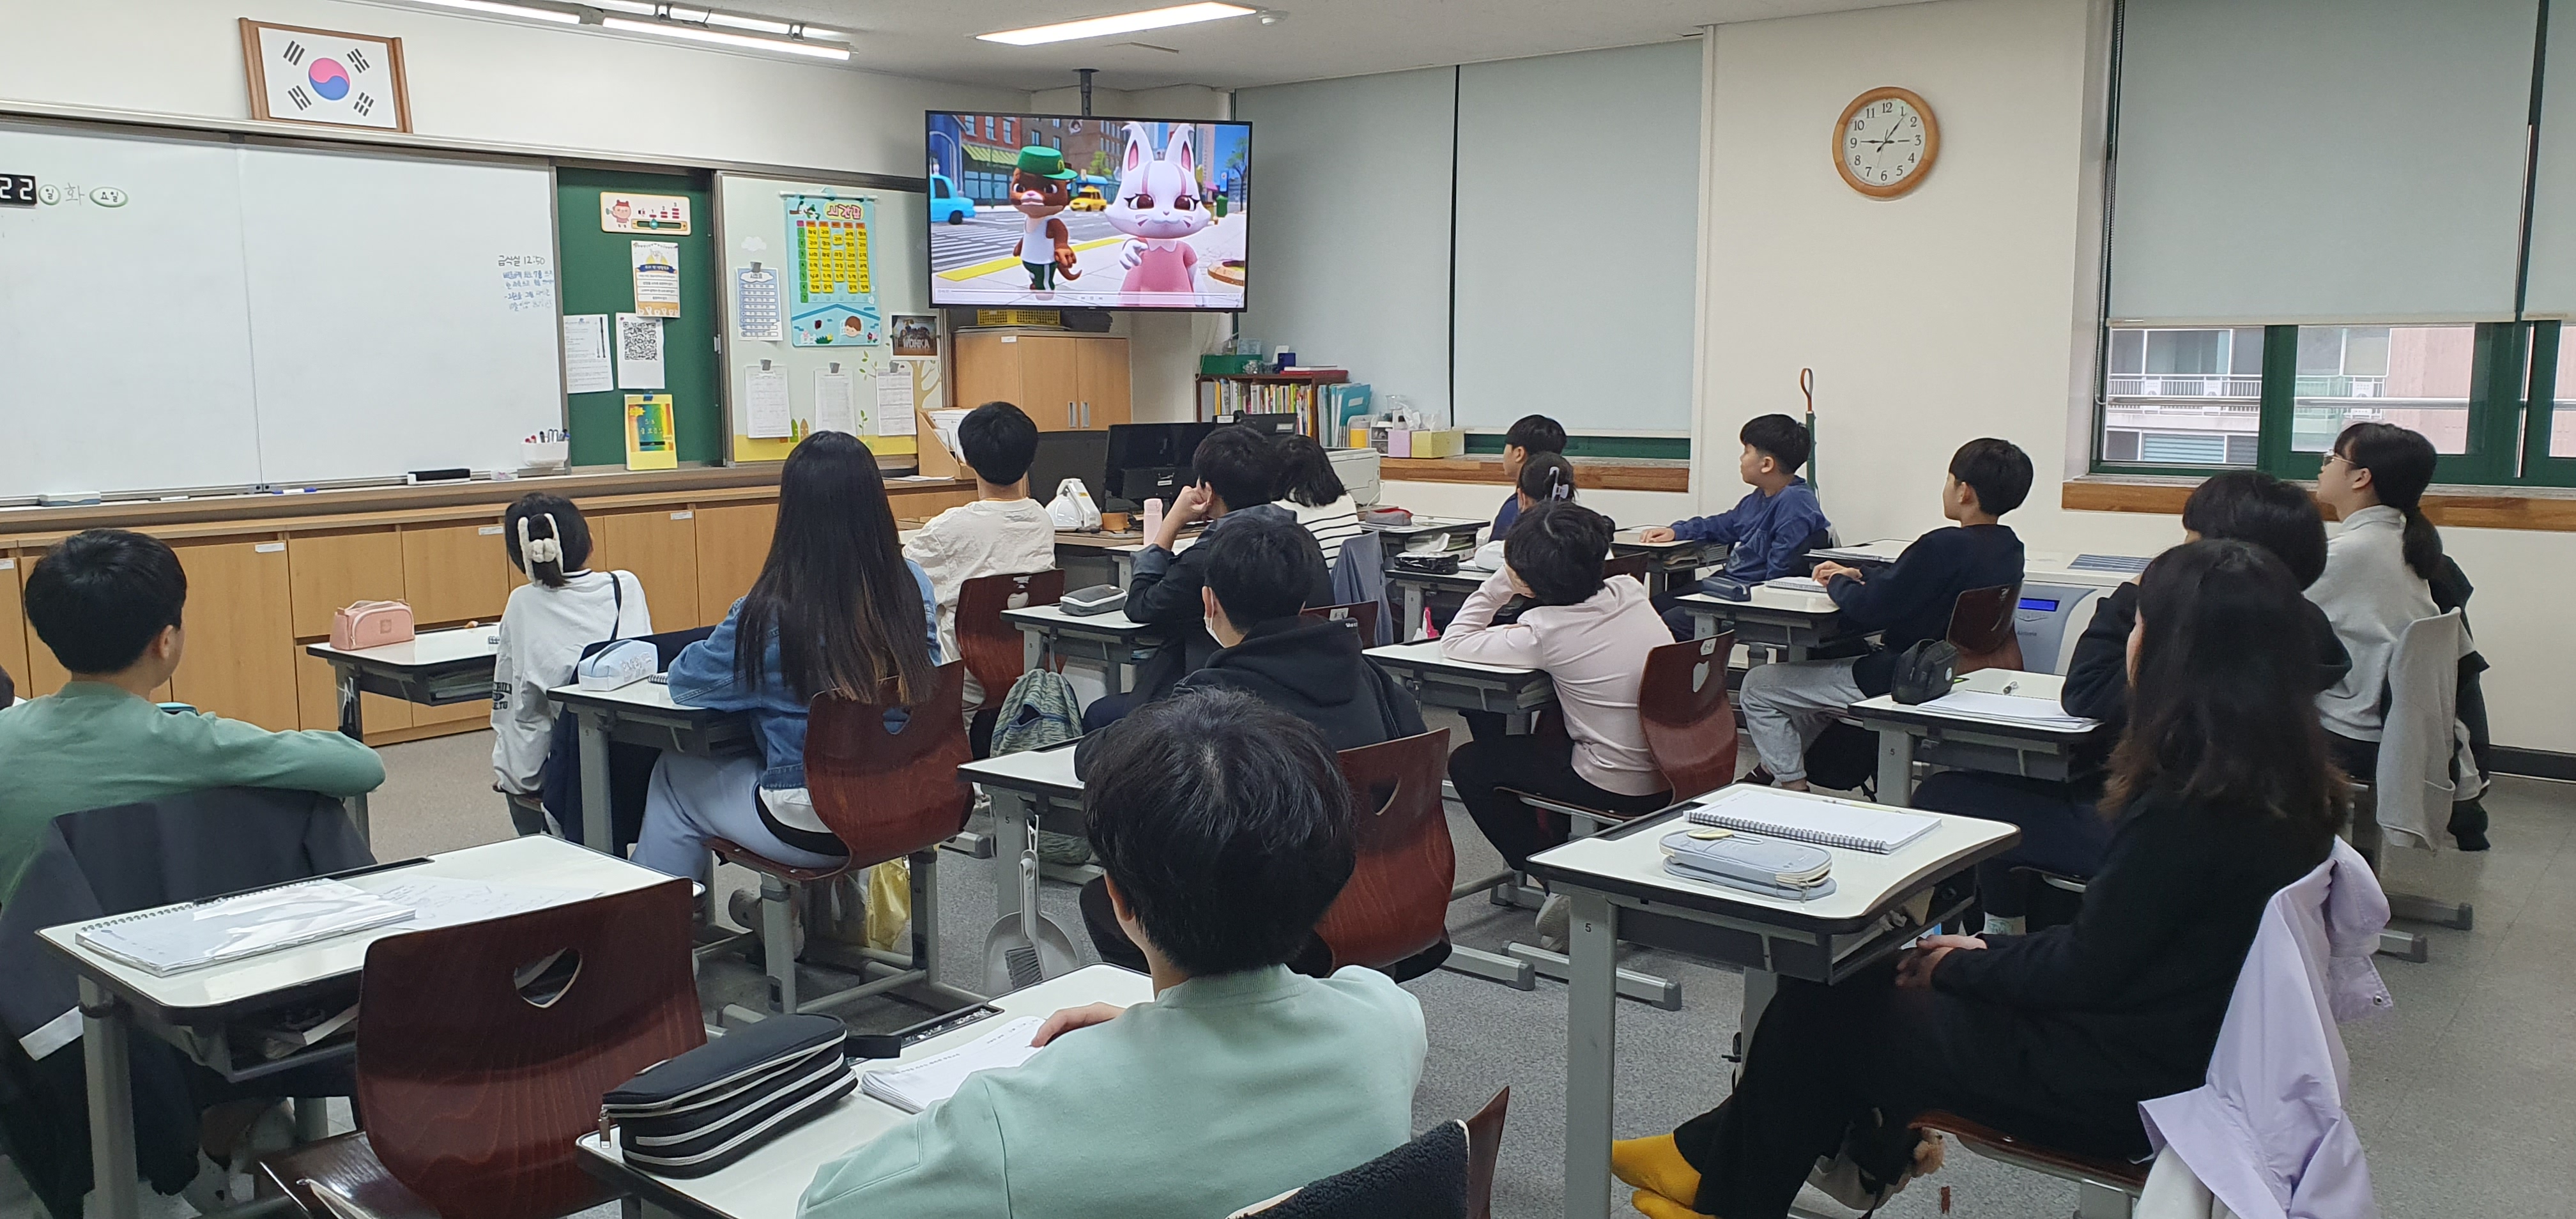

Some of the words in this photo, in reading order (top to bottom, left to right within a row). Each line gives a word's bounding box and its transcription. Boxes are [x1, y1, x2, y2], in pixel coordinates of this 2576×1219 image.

[1882, 102, 1892, 113] 12
[1900, 106, 1905, 116] 1
[1866, 108, 1874, 118] 11
[1854, 120, 1864, 130] 10
[1910, 116, 1917, 127] 2
[1850, 138, 1857, 148] 9
[1915, 135, 1921, 146] 3
[1855, 155, 1860, 165] 8
[1908, 153, 1914, 163] 4
[1866, 167, 1872, 177] 7
[1896, 165, 1903, 176] 5
[1881, 171, 1887, 181] 6
[45, 188, 54, 200] 일
[64, 182, 85, 206] 화
[100, 191, 119, 203] 요일
[826, 204, 862, 220] 시간표
[498, 255, 521, 267] 급식실
[523, 256, 546, 265] 12:50
[1890, 747, 1896, 756] 5
[1004, 816, 1010, 824] 5
[1584, 923, 1591, 933] 5
